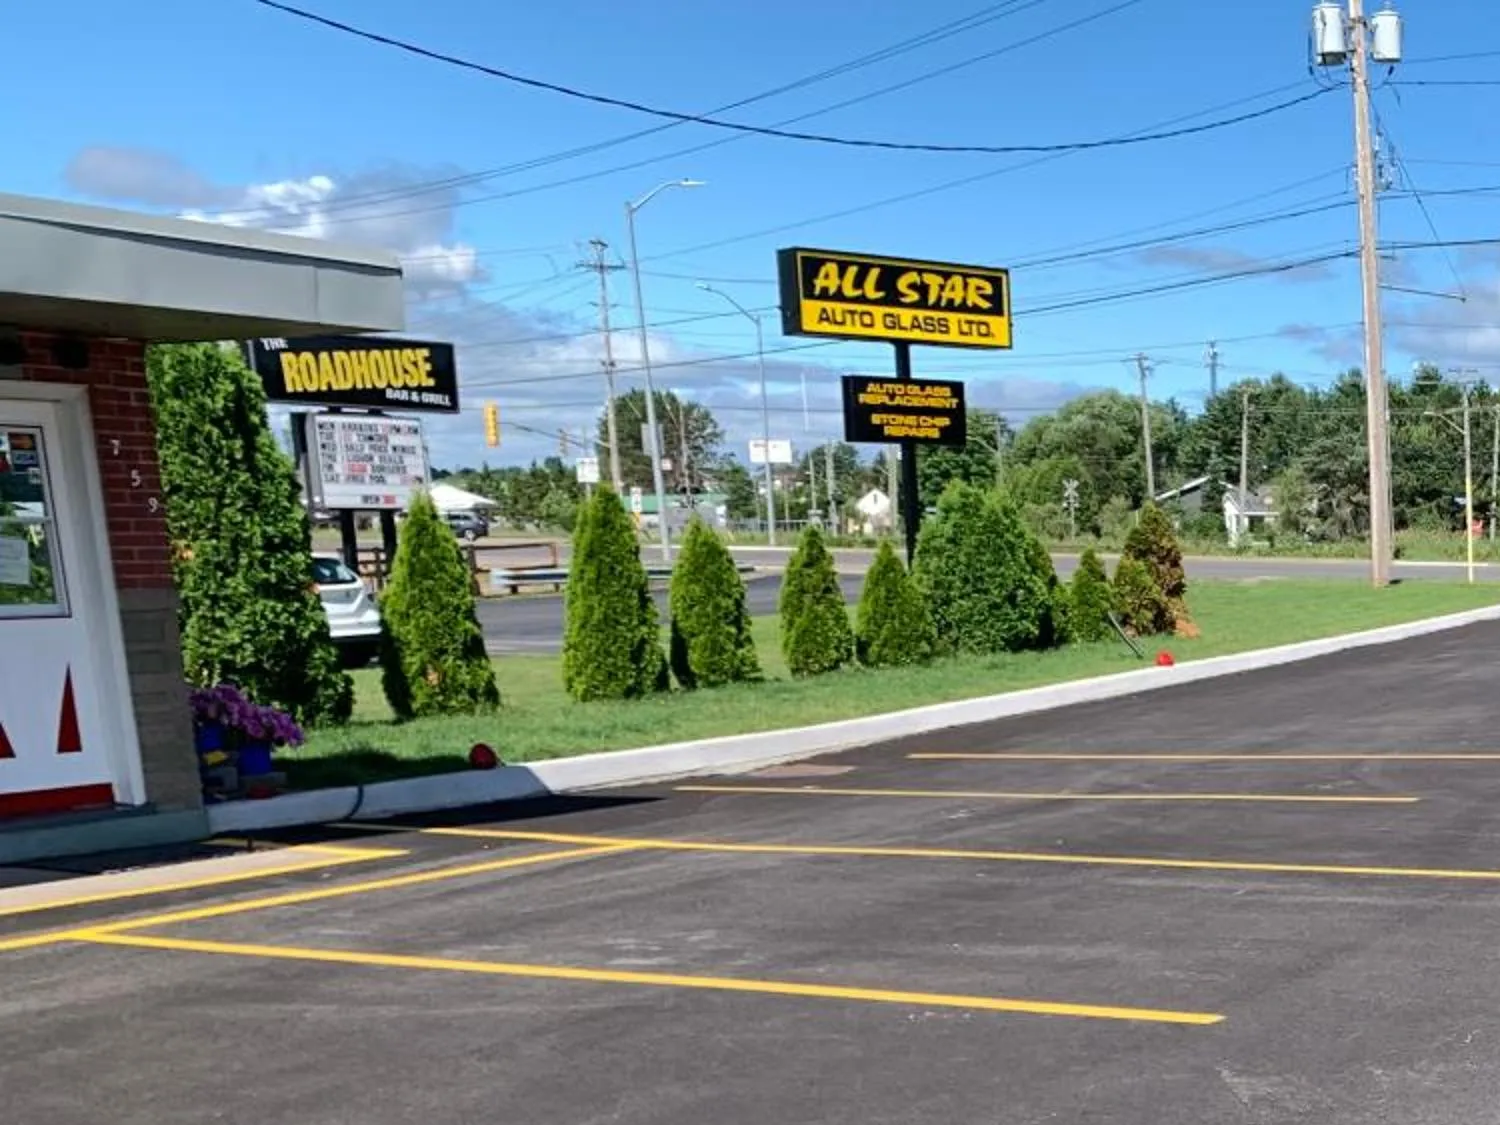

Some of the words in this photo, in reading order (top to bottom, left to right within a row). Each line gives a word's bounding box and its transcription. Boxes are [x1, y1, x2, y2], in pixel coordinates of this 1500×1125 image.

[813, 262, 886, 300] ALL
[896, 271, 993, 309] STAR
[817, 307, 875, 328] AUTO
[882, 312, 950, 335] GLASS
[957, 318, 996, 338] LTD.
[261, 337, 288, 350] THE
[280, 348, 435, 392] ROADHOUSE
[385, 389, 409, 401] BAR
[411, 391, 421, 402] &
[422, 392, 451, 406] GRILL
[867, 383, 904, 394] AUTO
[907, 385, 951, 396] GLASS
[859, 394, 959, 408] REPLACEMENT
